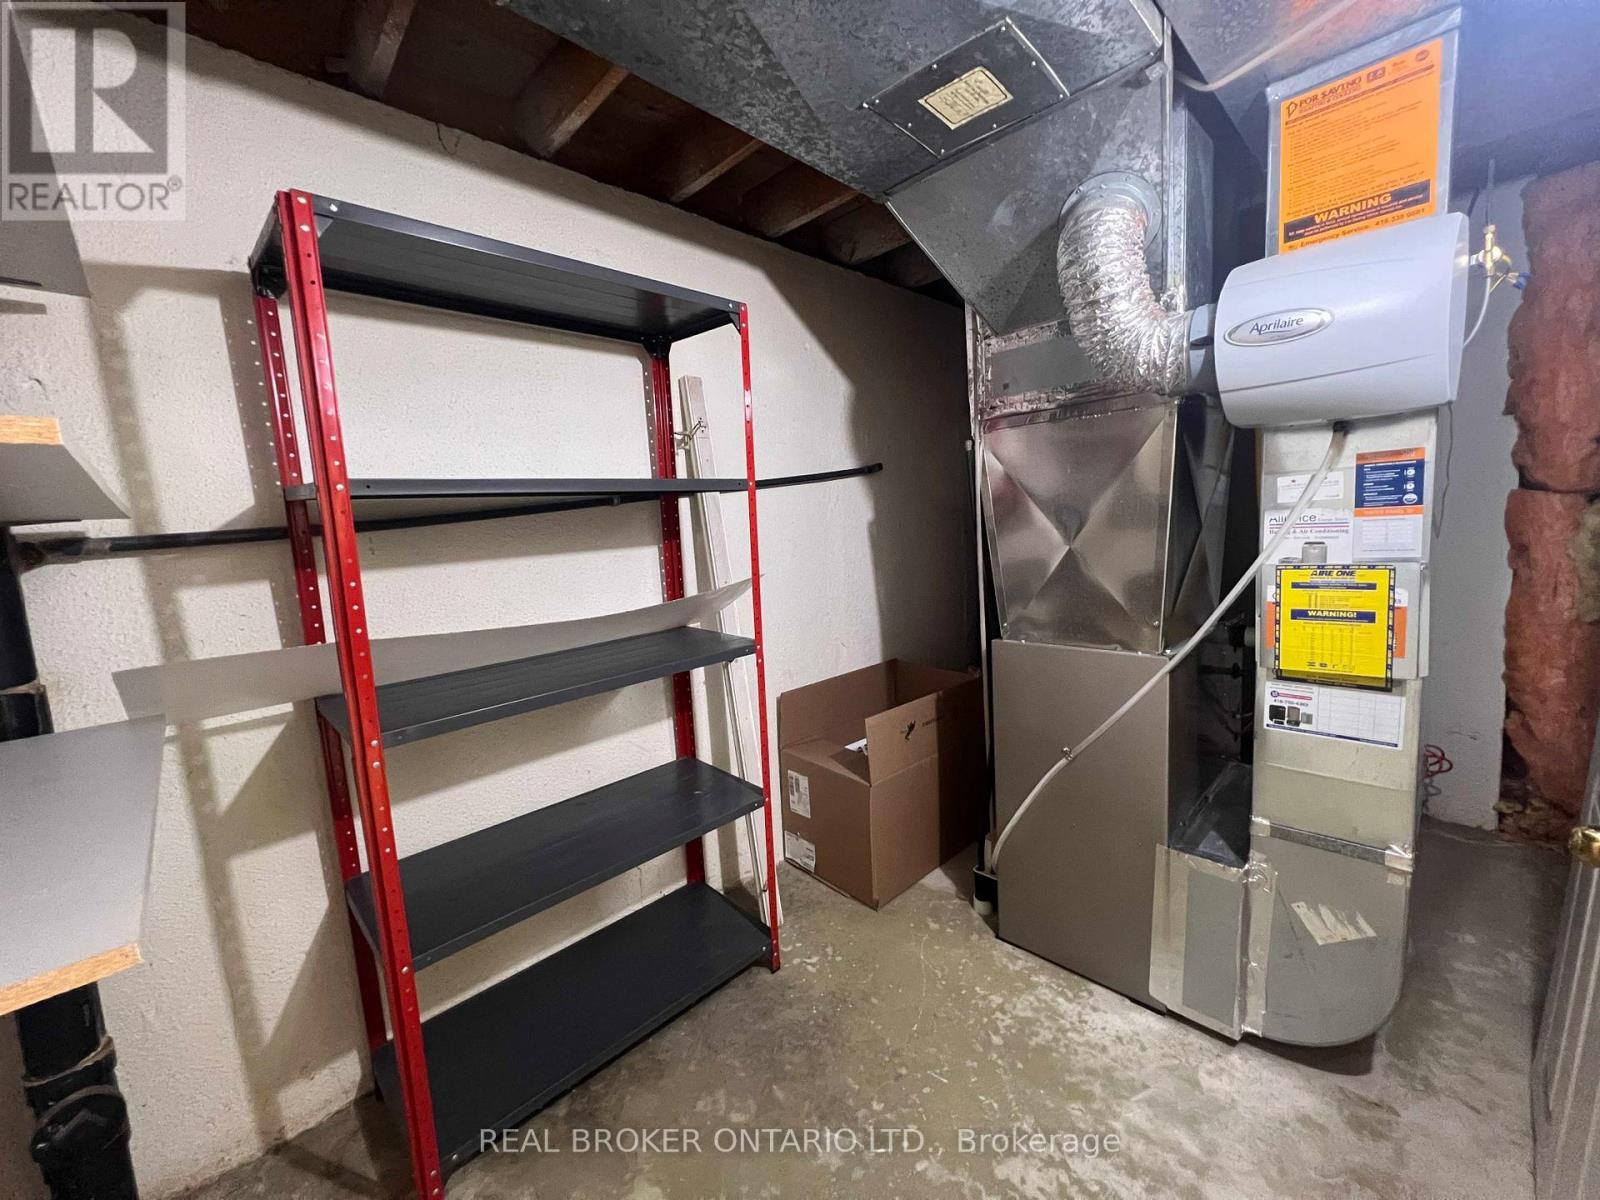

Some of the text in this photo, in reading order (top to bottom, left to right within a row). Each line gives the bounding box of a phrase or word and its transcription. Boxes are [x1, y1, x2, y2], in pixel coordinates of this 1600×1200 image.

[1314, 193, 1392, 224] WARNING
[1249, 317, 1304, 336] Aprilaire
[1310, 528, 1349, 536] Conditioning
[1307, 610, 1357, 618] WARNING!
